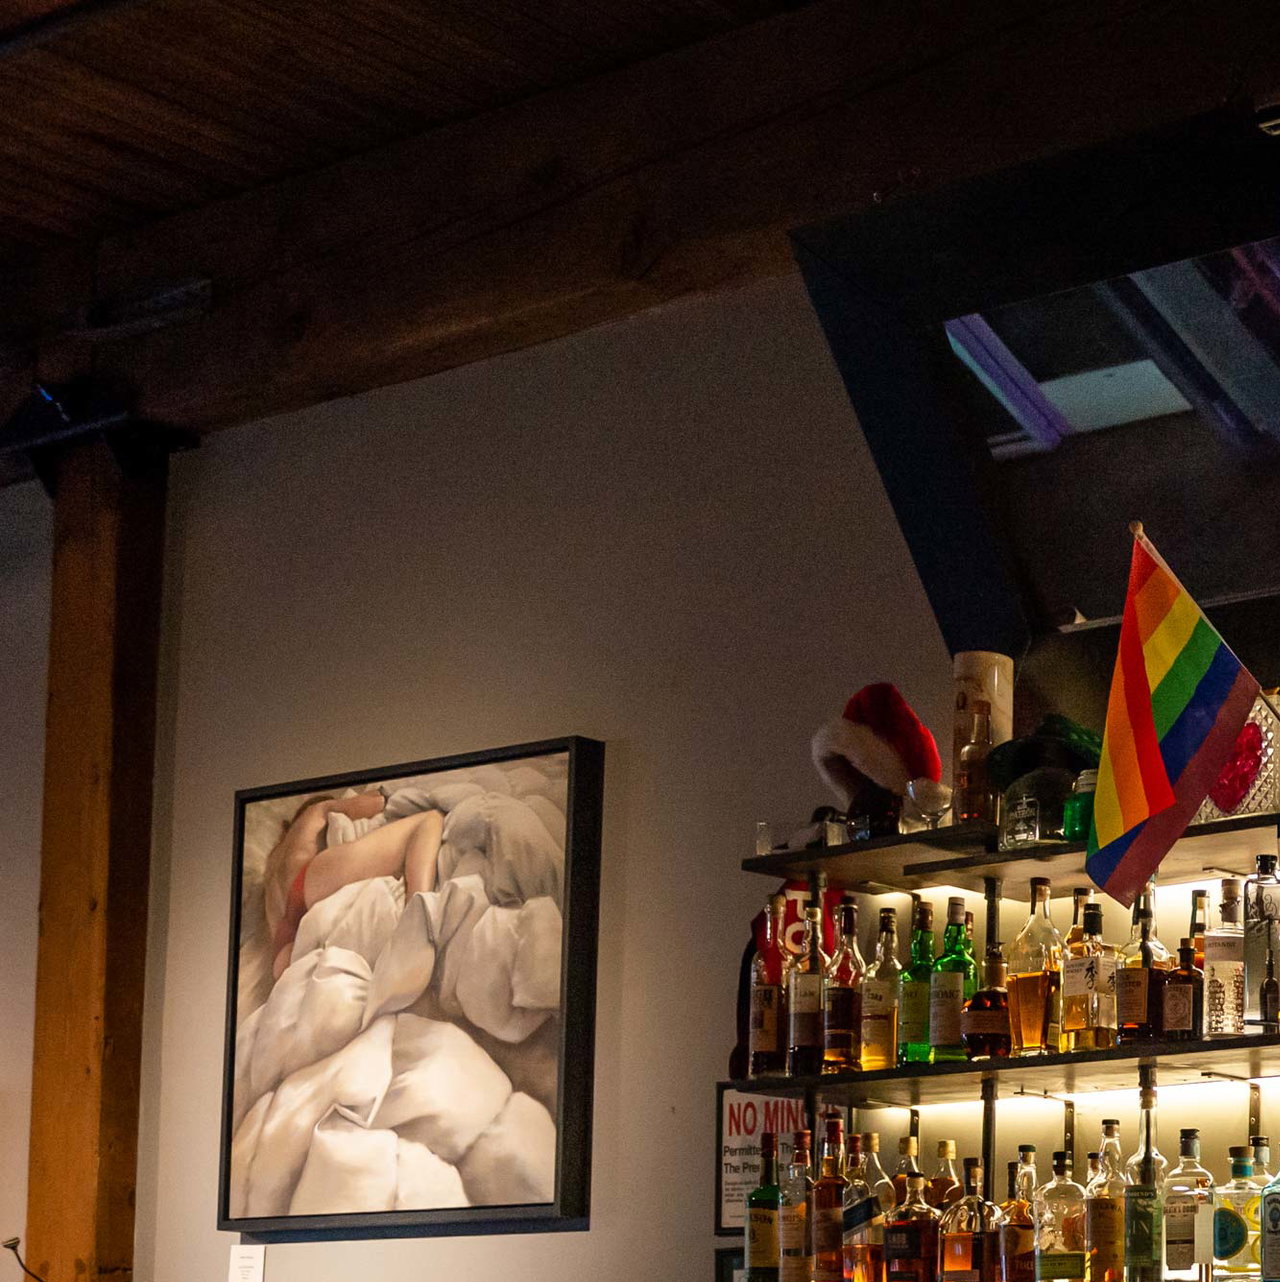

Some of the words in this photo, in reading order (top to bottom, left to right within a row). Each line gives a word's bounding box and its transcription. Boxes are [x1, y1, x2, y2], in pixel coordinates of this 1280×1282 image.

[730, 1101, 757, 1137] NO
[723, 1144, 762, 1157] Permitte
[724, 1162, 741, 1174] The
